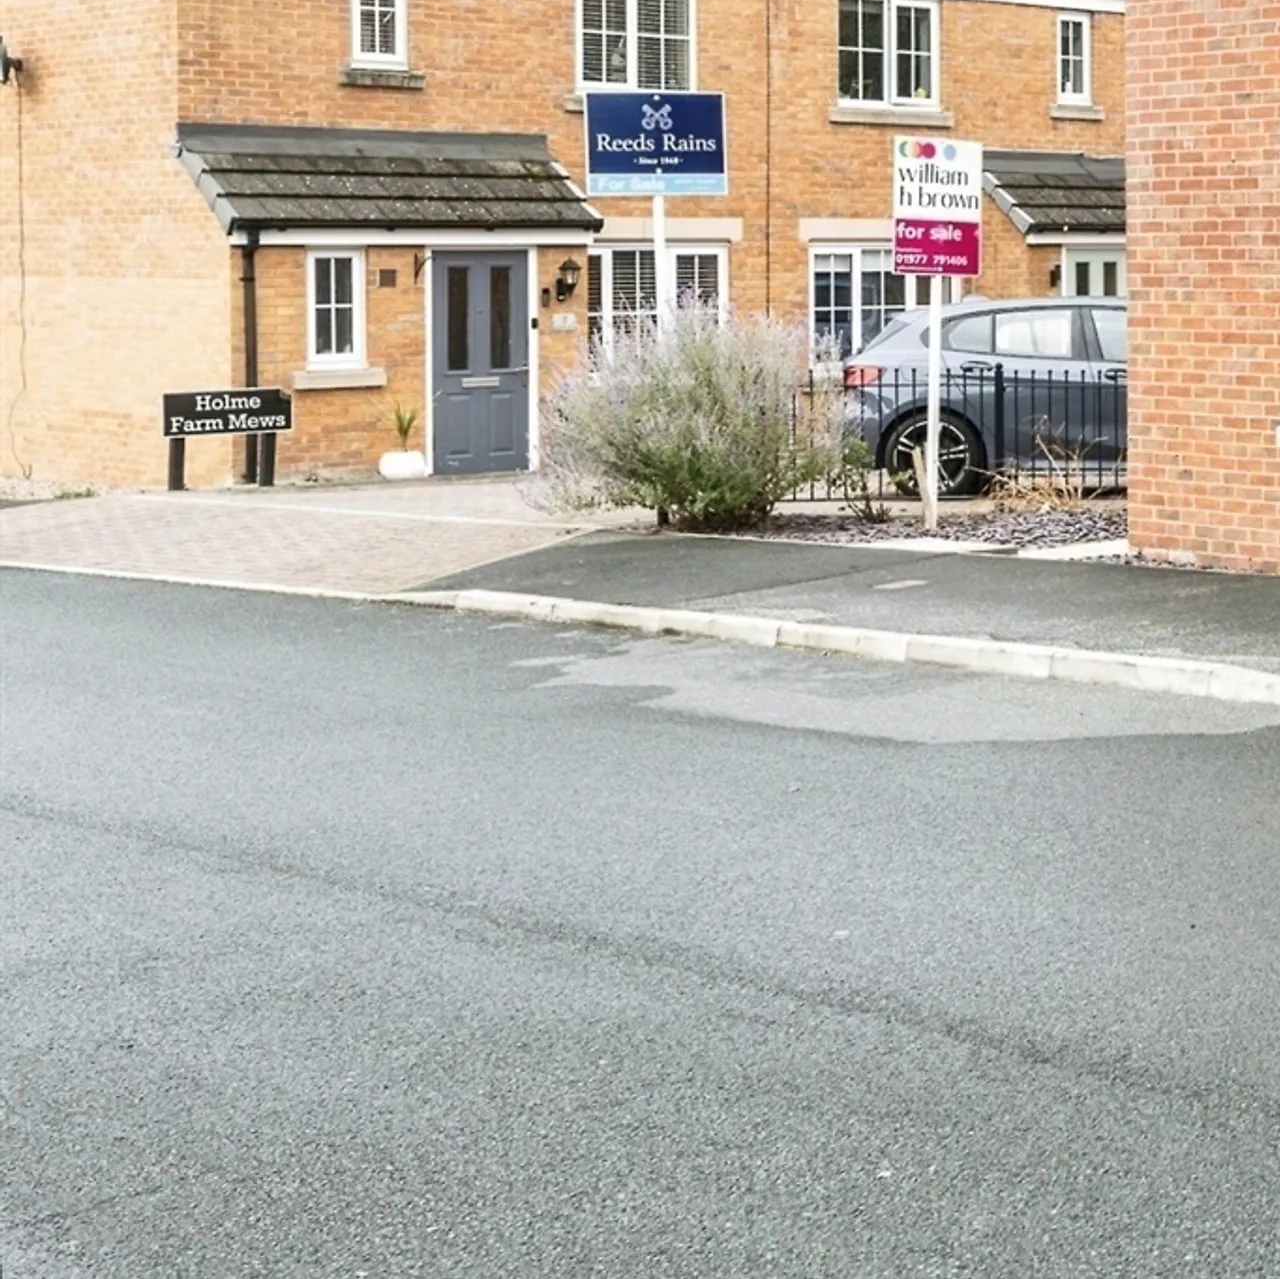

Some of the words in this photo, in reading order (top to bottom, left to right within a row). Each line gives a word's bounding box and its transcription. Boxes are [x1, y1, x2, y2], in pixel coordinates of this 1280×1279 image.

[596, 133, 655, 152] Reeds
[663, 133, 717, 152] Rains
[598, 177, 626, 190] For
[631, 175, 665, 190] Sale
[899, 163, 969, 186] william
[900, 186, 912, 206] h
[919, 186, 979, 210] brown
[896, 222, 926, 239] for
[929, 224, 963, 242] sale
[896, 254, 928, 264] 01977
[195, 395, 261, 411] Holme
[170, 417, 224, 432] Farm
[227, 414, 286, 429] Mews
